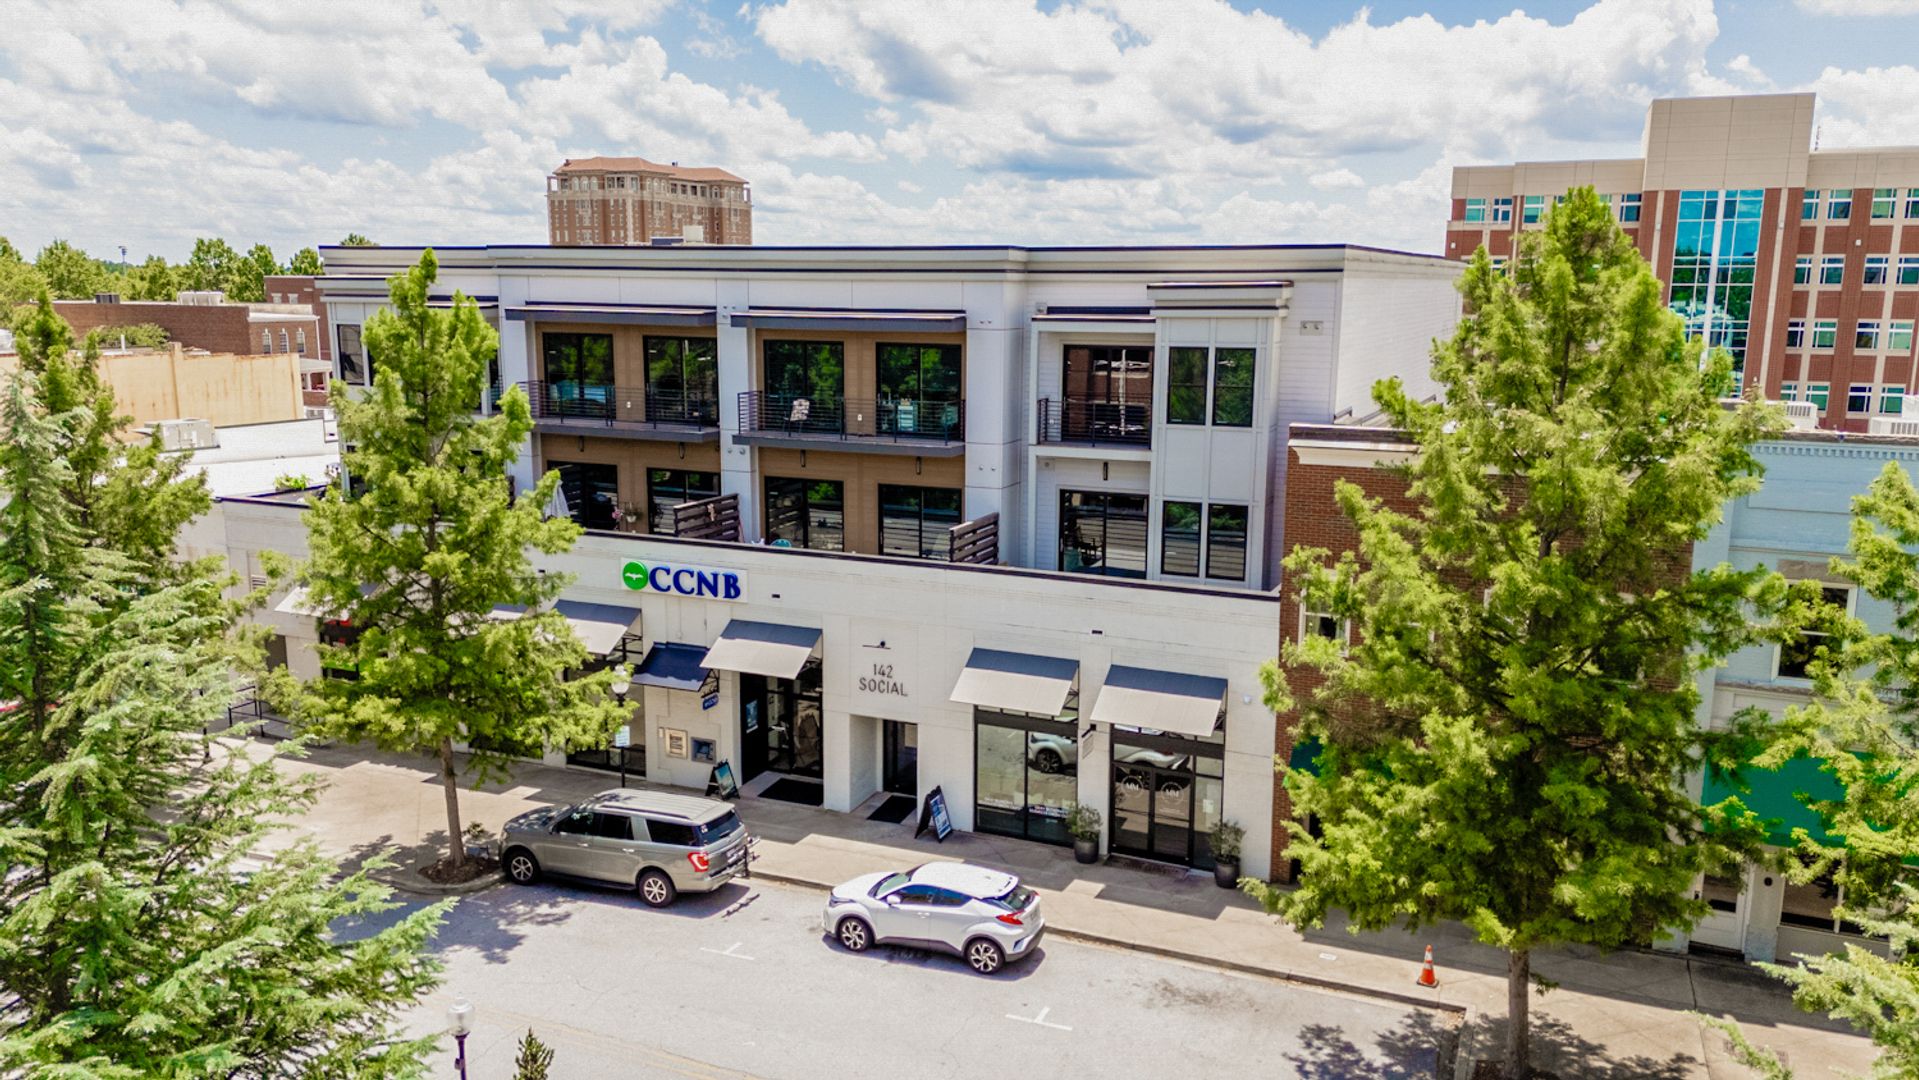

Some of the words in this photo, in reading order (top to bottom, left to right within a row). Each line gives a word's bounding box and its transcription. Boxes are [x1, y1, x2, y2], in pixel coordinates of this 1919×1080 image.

[648, 565, 741, 599] CCNB
[873, 663, 894, 679] 142
[858, 676, 909, 697] SOCIAL
